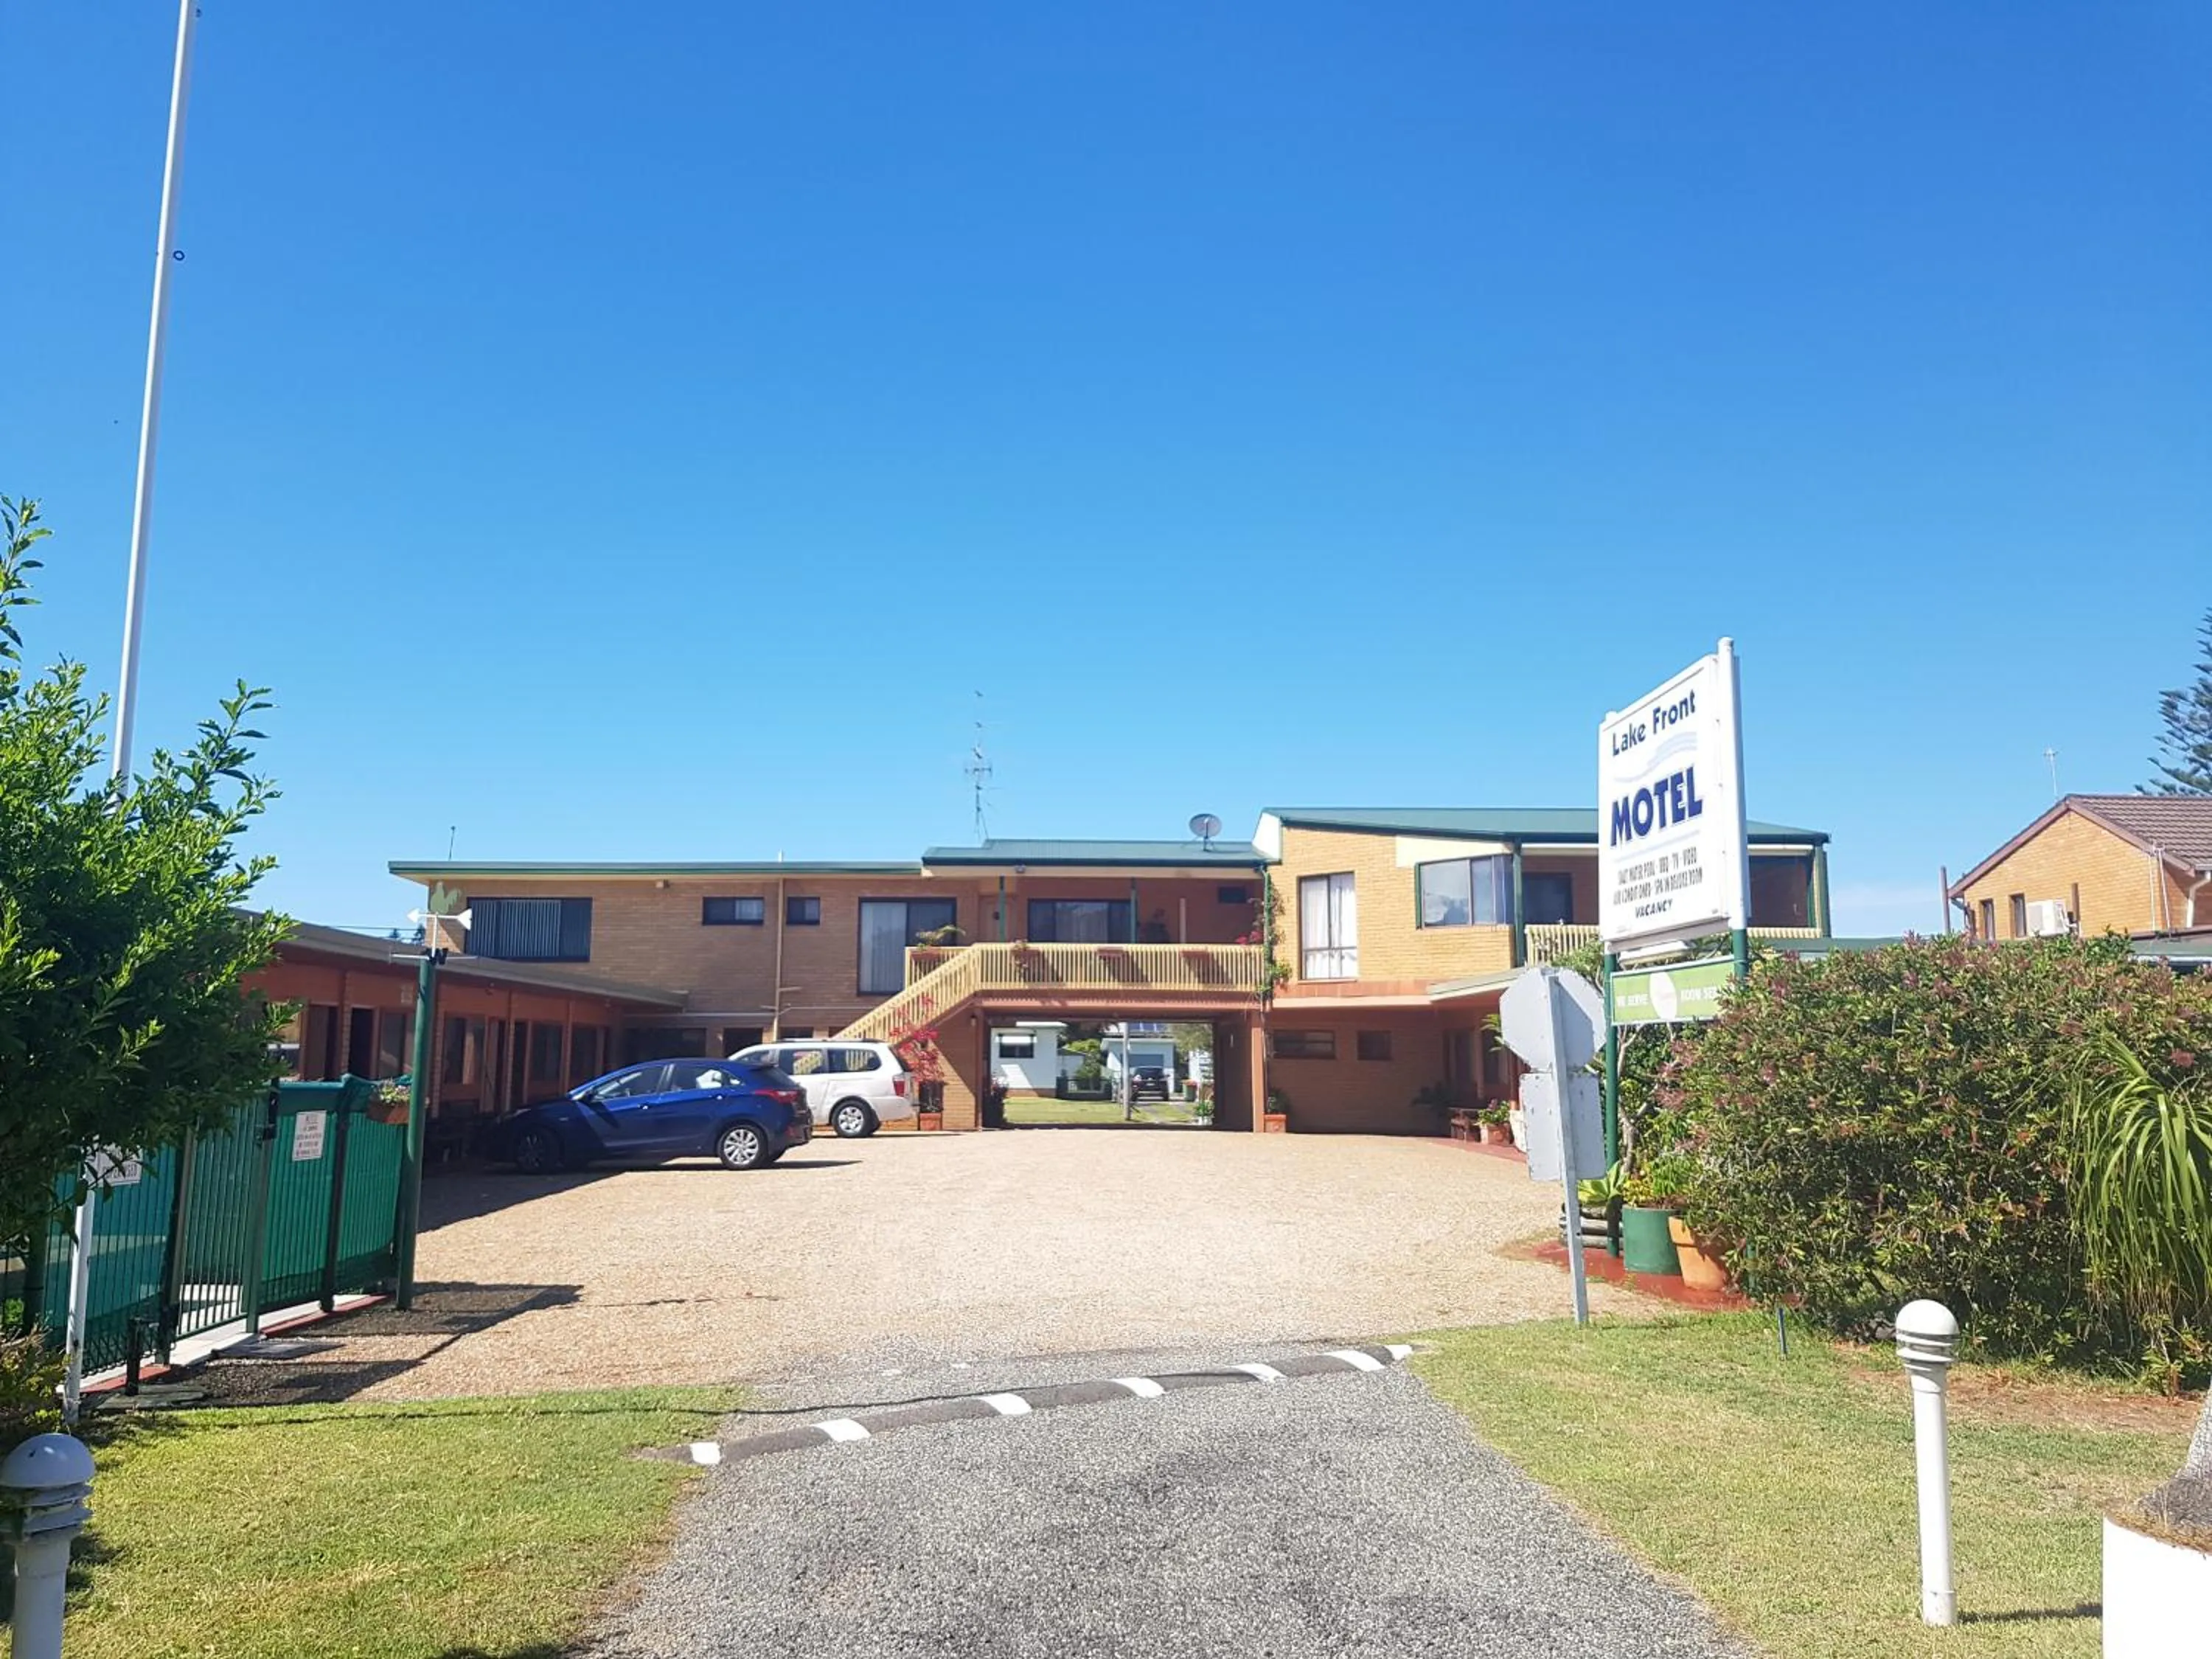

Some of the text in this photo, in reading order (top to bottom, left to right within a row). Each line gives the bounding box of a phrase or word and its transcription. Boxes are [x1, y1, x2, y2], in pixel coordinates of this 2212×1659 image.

[1612, 689, 1697, 757] Lake Front
[1610, 765, 1703, 847] MOTEL
[1635, 898, 1673, 919] VACANCY
